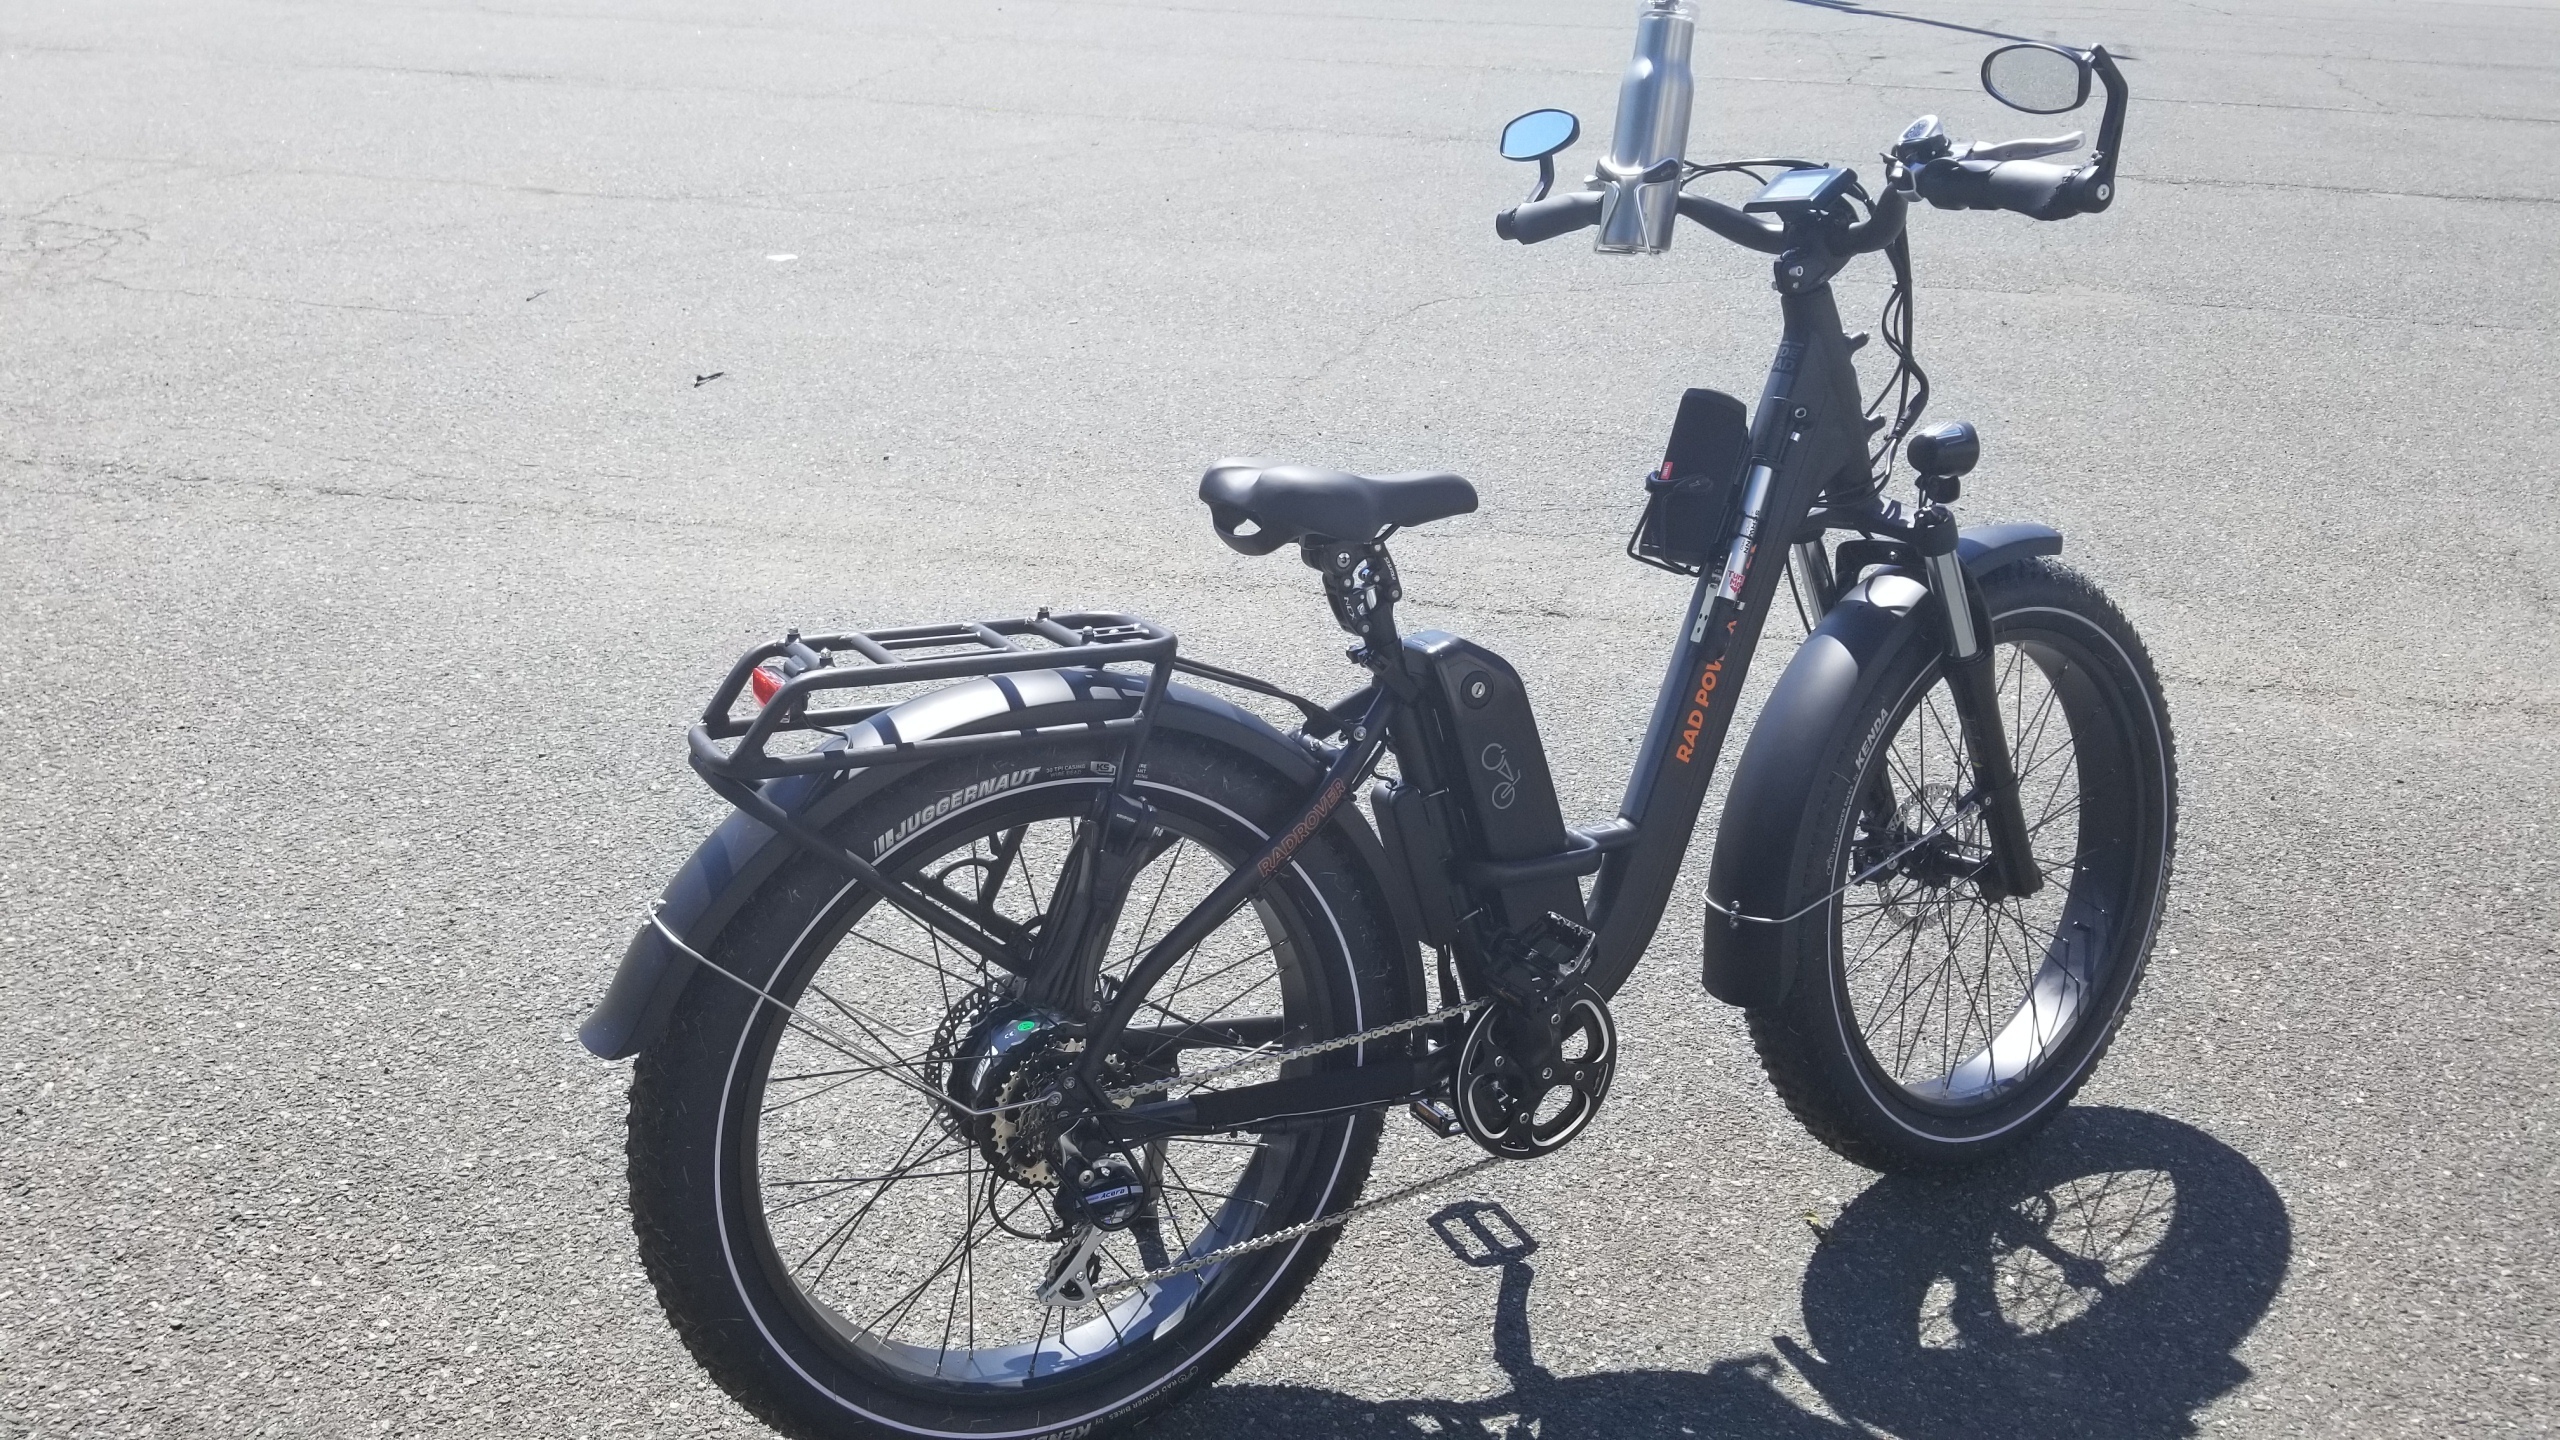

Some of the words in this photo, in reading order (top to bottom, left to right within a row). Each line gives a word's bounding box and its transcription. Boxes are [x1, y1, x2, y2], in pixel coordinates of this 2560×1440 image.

[1744, 510, 1760, 554] SCHWNN
[1676, 710, 1704, 763] RAD
[1855, 708, 1889, 770] KENDA
[895, 766, 1041, 842] JUGGERNAUT
[1258, 777, 1345, 877] RADROVER
[1101, 1188, 1125, 1199] Acera
[1132, 1391, 1160, 1409] POWER
[1161, 1379, 1178, 1393] RAD
[1108, 1405, 1131, 1420] BIKES
[1030, 1422, 1092, 1440] KEND
